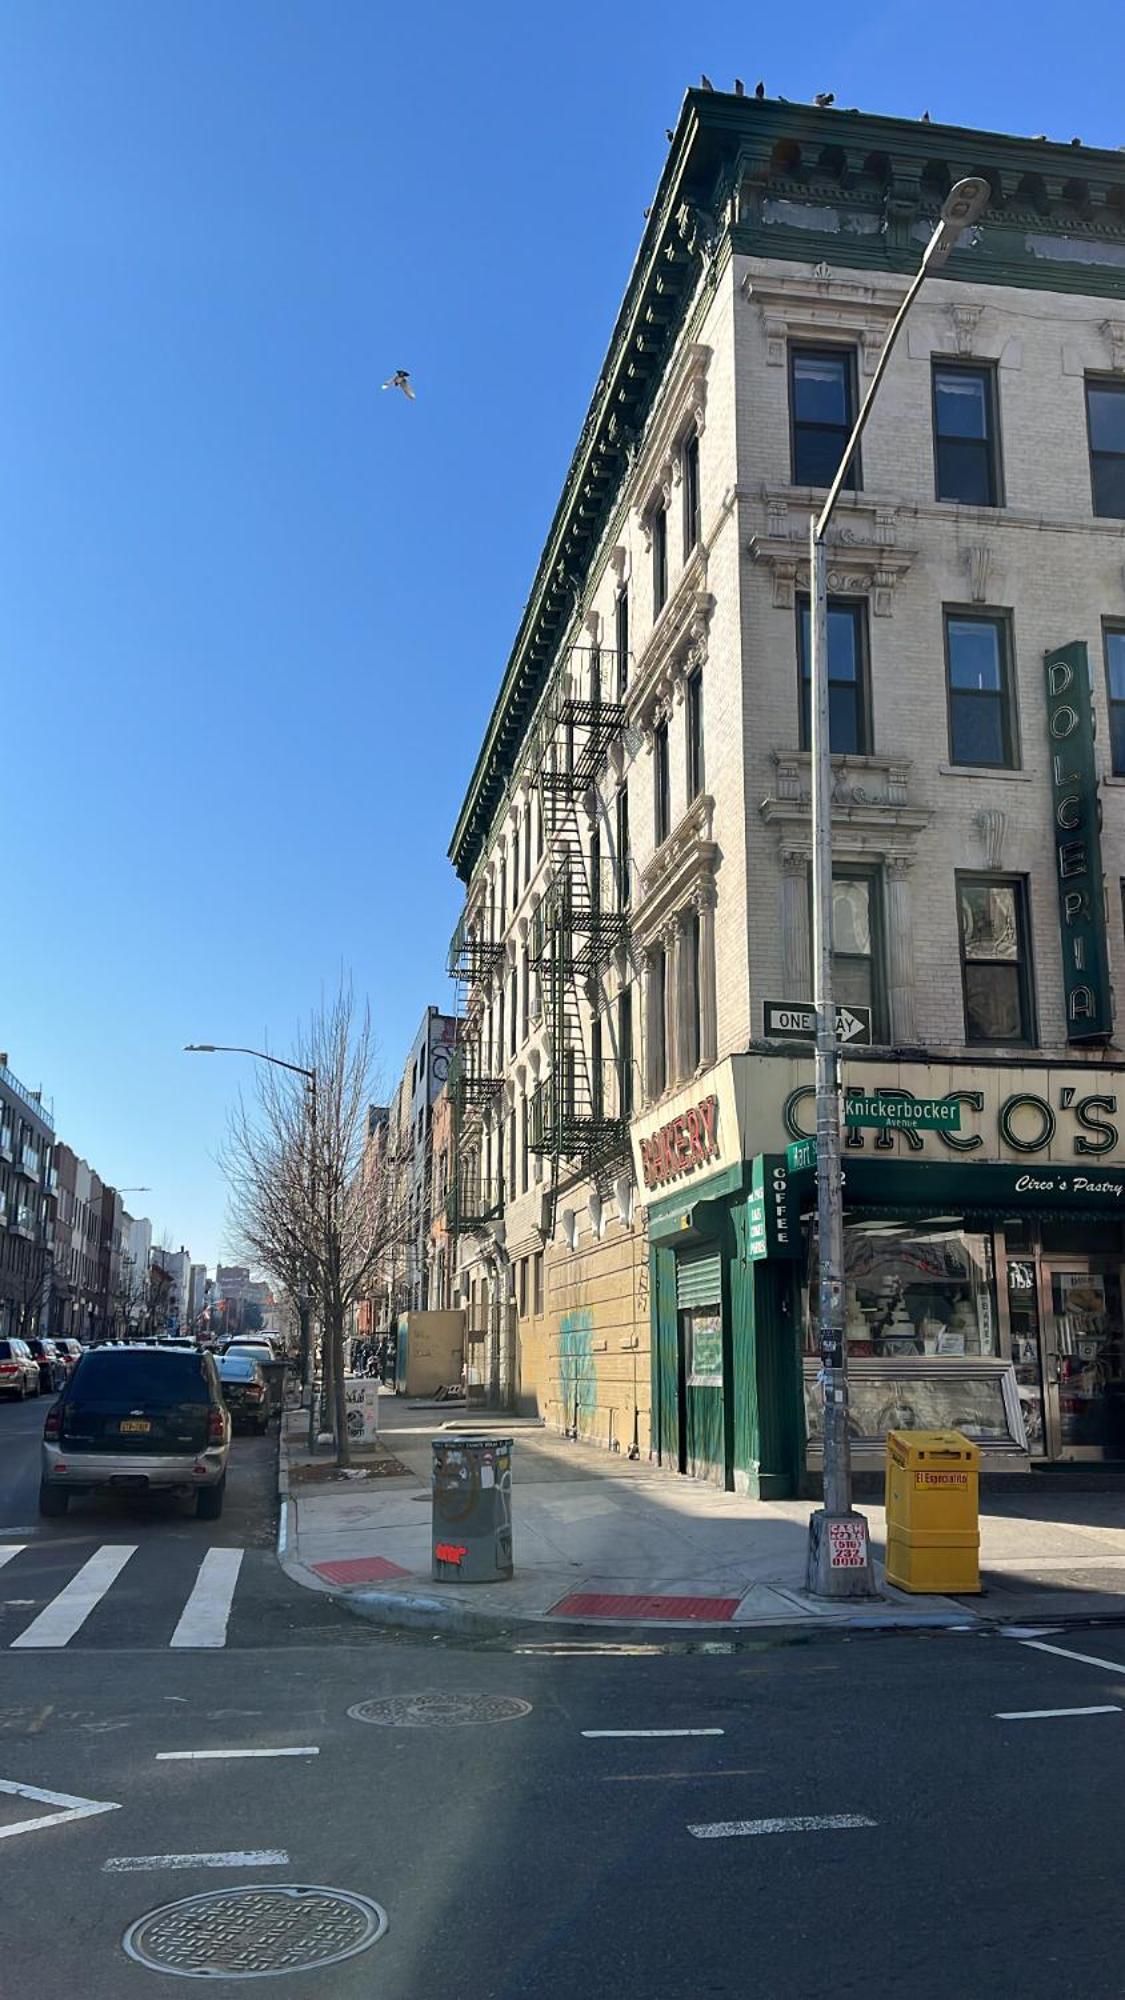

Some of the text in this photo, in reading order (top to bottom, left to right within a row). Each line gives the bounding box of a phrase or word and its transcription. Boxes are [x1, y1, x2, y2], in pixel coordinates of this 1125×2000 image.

[1048, 662, 1096, 1019] DOLCERIA
[779, 1013, 854, 1033] ONE AY
[845, 1100, 956, 1119] Knickerbocker
[886, 1118, 918, 1128] Avenue
[639, 1095, 720, 1188] BAKERY
[1015, 1175, 1123, 1196] Circo's Pastry
[772, 1167, 789, 1243] COFFEE
